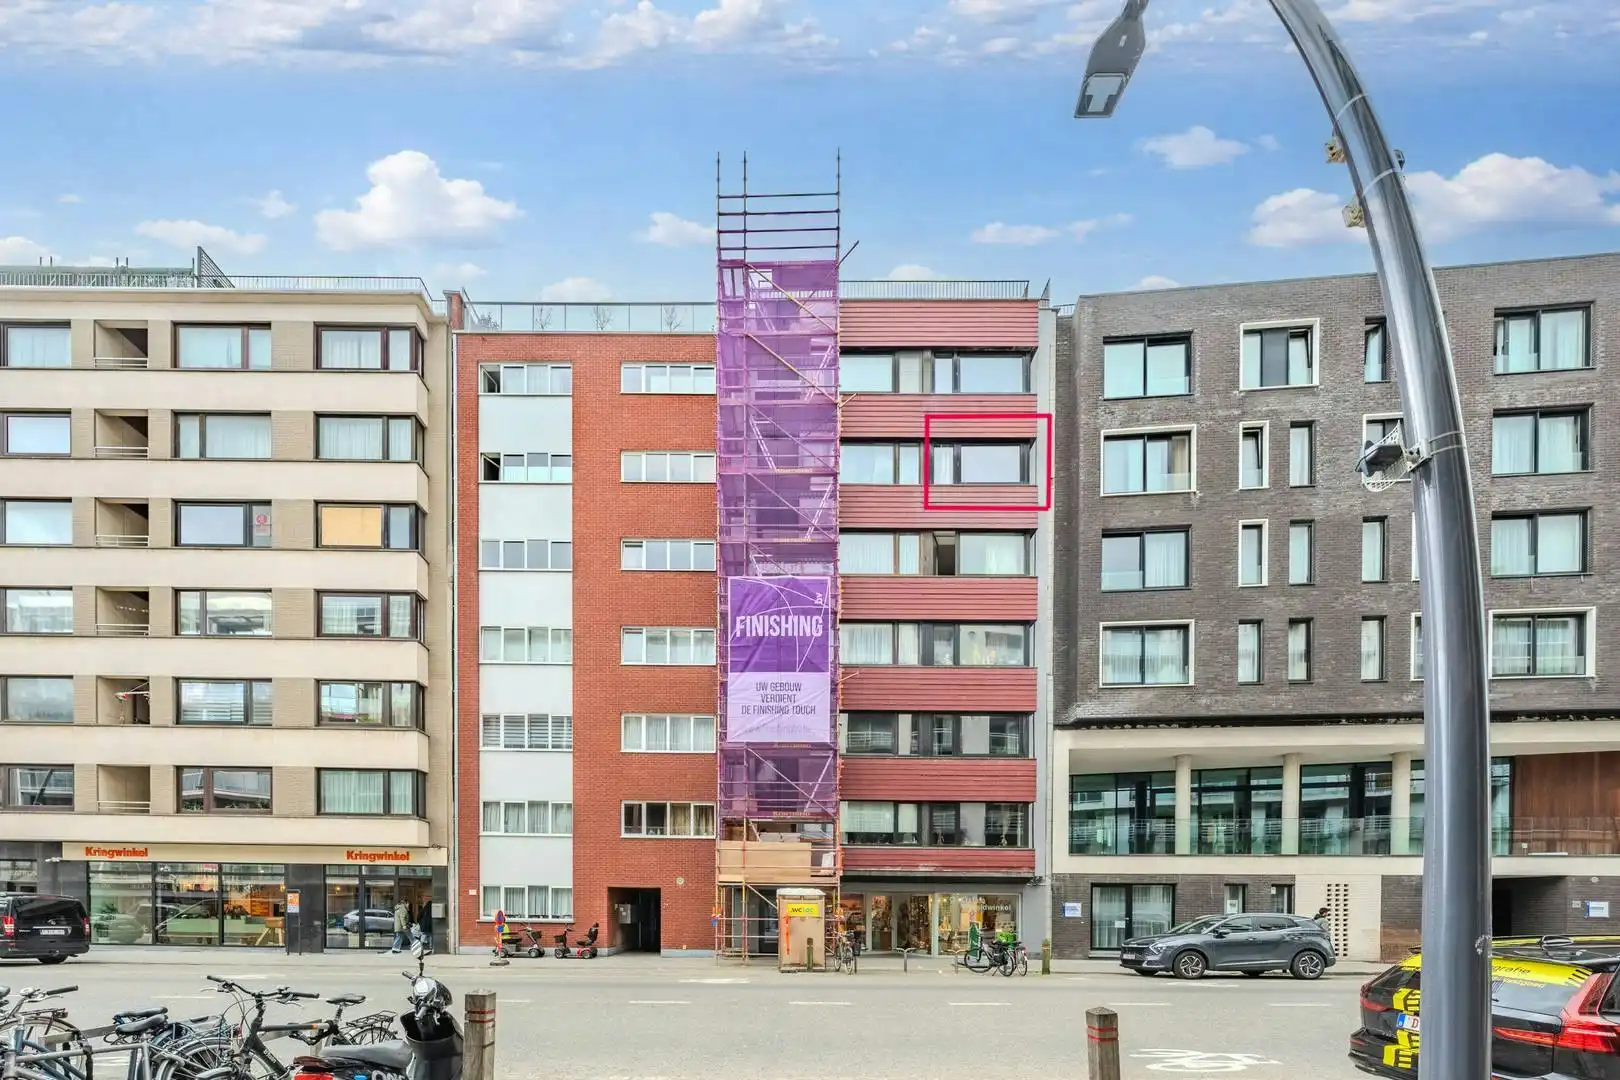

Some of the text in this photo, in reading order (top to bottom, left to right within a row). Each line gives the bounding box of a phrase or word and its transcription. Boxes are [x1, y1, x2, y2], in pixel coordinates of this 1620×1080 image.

[736, 615, 823, 637] FINISHING
[755, 682, 802, 692] UW GEBOUW
[760, 693, 797, 704] VERDIENT
[741, 705, 816, 715] DE FINISHING TOUCH
[85, 846, 148, 859] Kringwinkel
[346, 850, 410, 862] Kringwinkel
